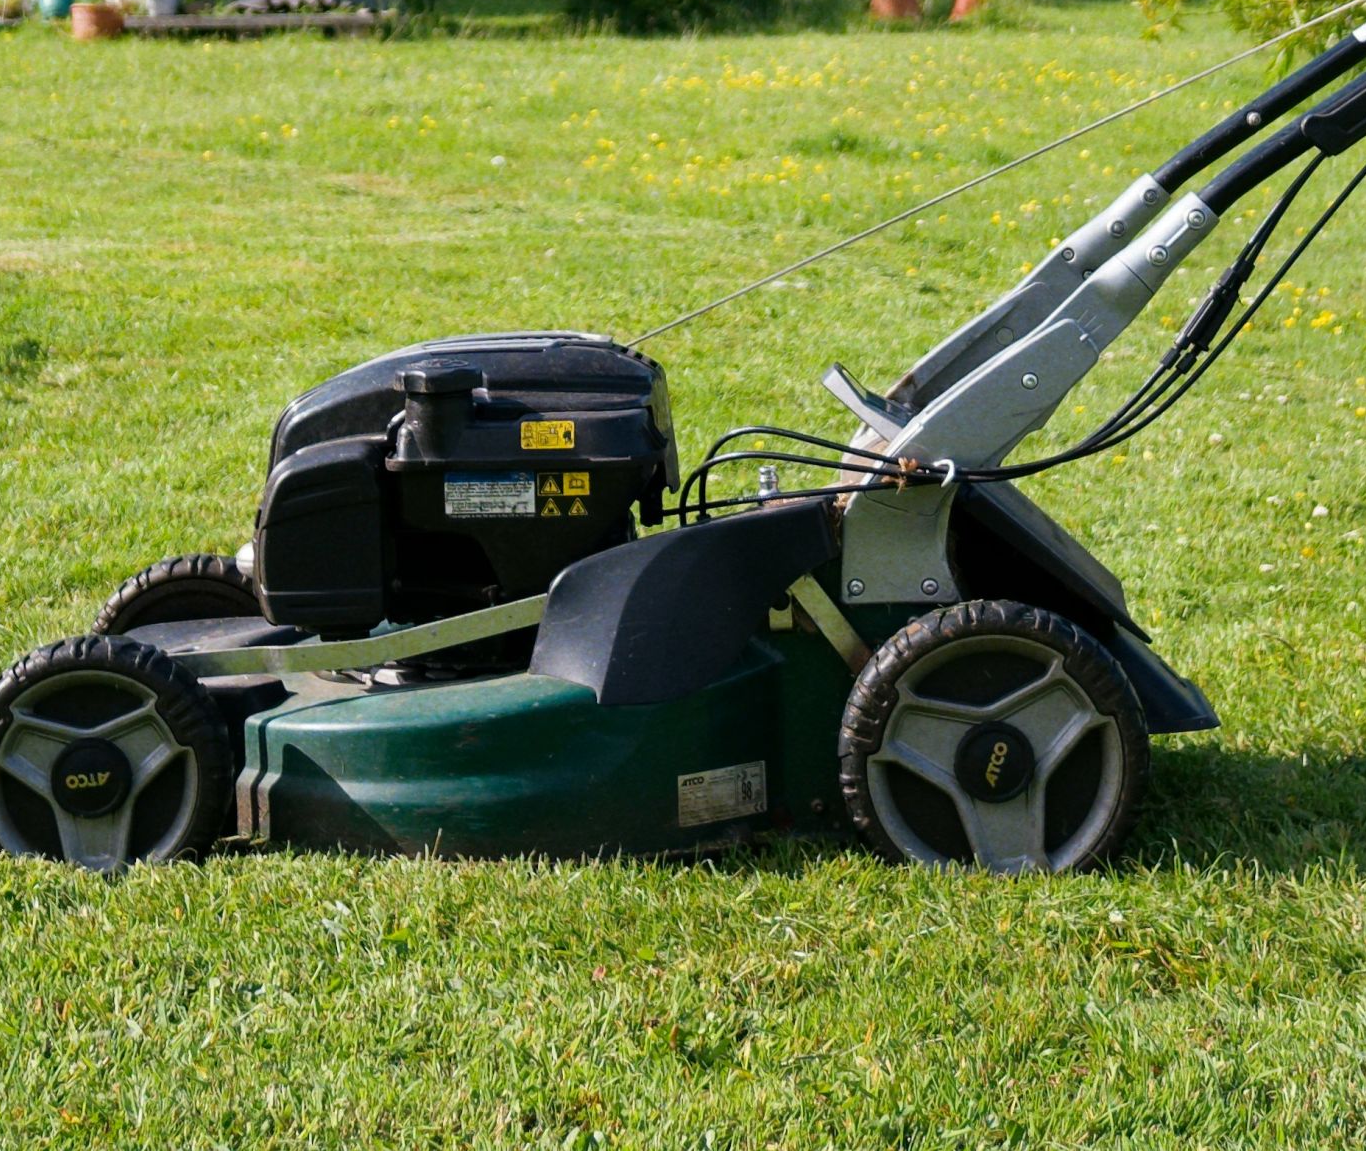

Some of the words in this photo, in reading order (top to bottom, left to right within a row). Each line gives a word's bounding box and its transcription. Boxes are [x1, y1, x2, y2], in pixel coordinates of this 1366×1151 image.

[986, 742, 1008, 788] ATCO
[65, 772, 110, 789] ATCO
[681, 776, 705, 787] ATCO
